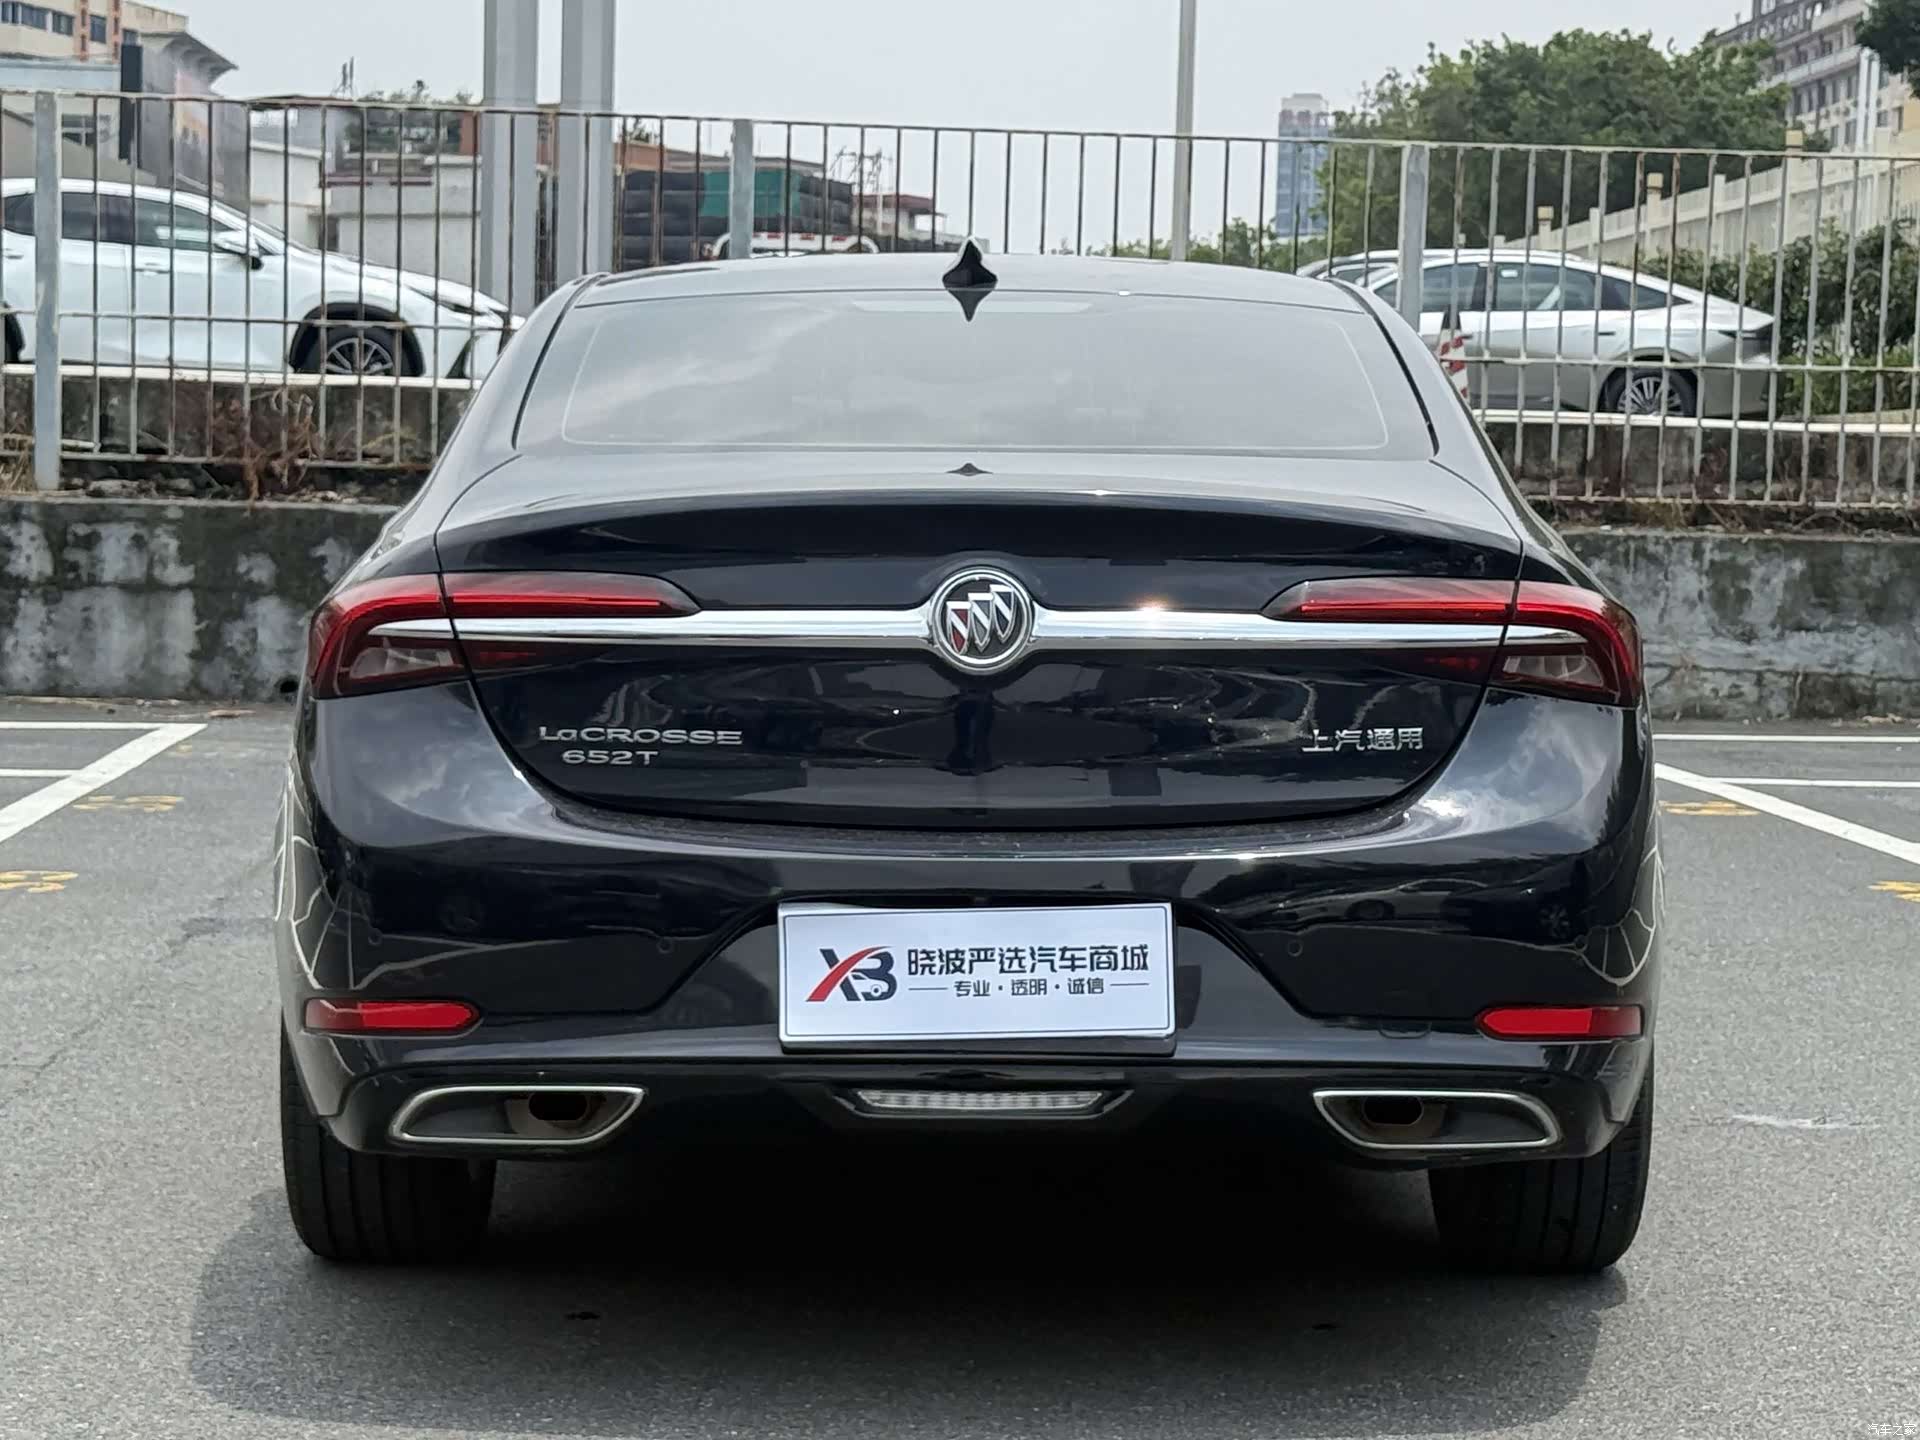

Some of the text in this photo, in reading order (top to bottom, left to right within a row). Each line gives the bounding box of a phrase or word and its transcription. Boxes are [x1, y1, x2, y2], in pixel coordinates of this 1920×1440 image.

[539, 726, 743, 745] LaCROSSE
[1302, 727, 1424, 752] 上汽通用
[561, 750, 659, 765] 652T
[907, 944, 1150, 977] 晓波严选汽车商城
